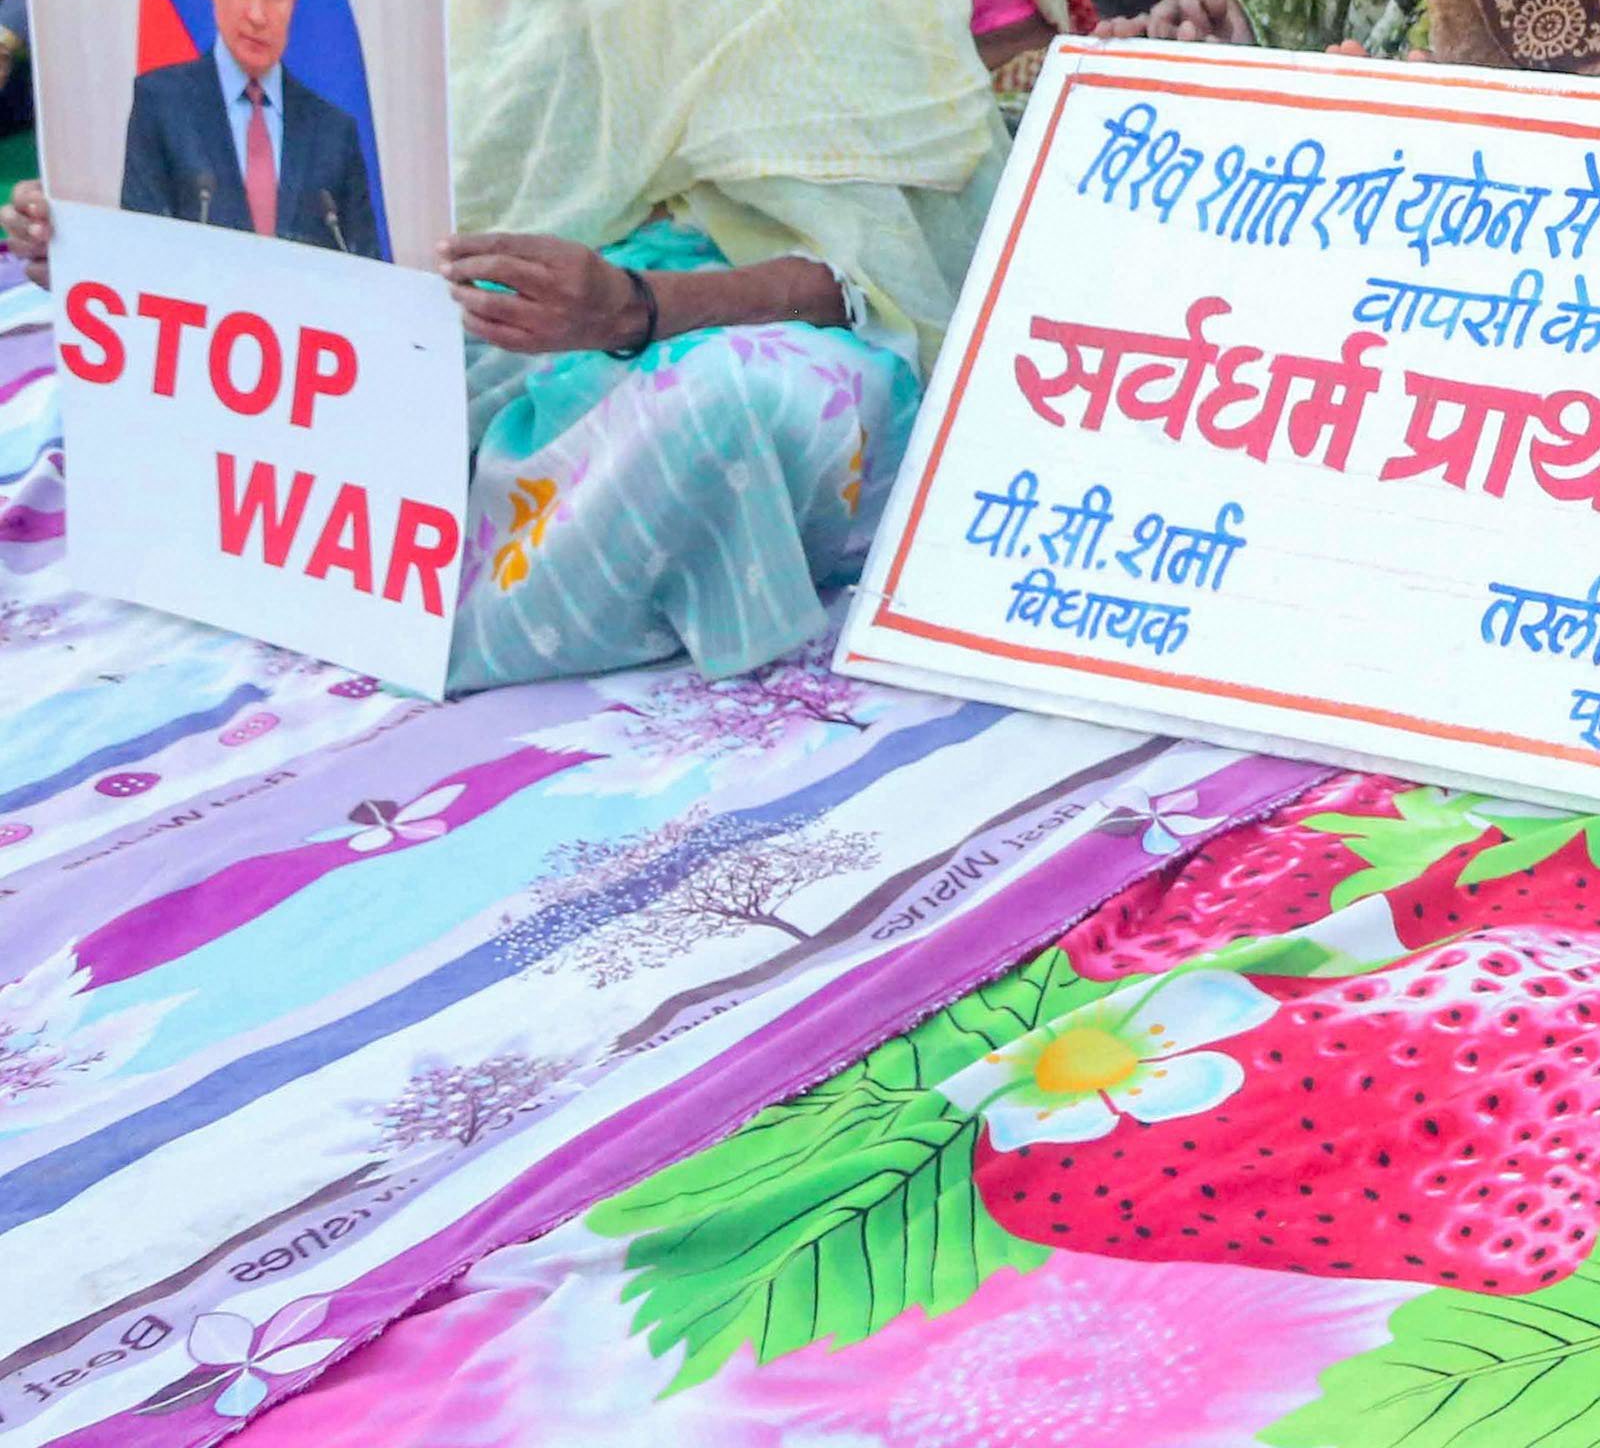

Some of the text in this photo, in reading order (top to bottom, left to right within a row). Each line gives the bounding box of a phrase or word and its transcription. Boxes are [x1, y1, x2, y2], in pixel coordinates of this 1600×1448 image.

[1077, 102, 1204, 224] विश्व
[1195, 138, 1326, 246] शांति
[1311, 149, 1406, 250] एवं
[1395, 149, 1553, 267] यूक्रेन
[59, 280, 359, 429] STOP
[1014, 295, 1389, 474] सर्वधर्म
[1352, 268, 1545, 349] वापसी
[215, 451, 460, 619] WAR
[1005, 567, 1192, 656] विधायक
